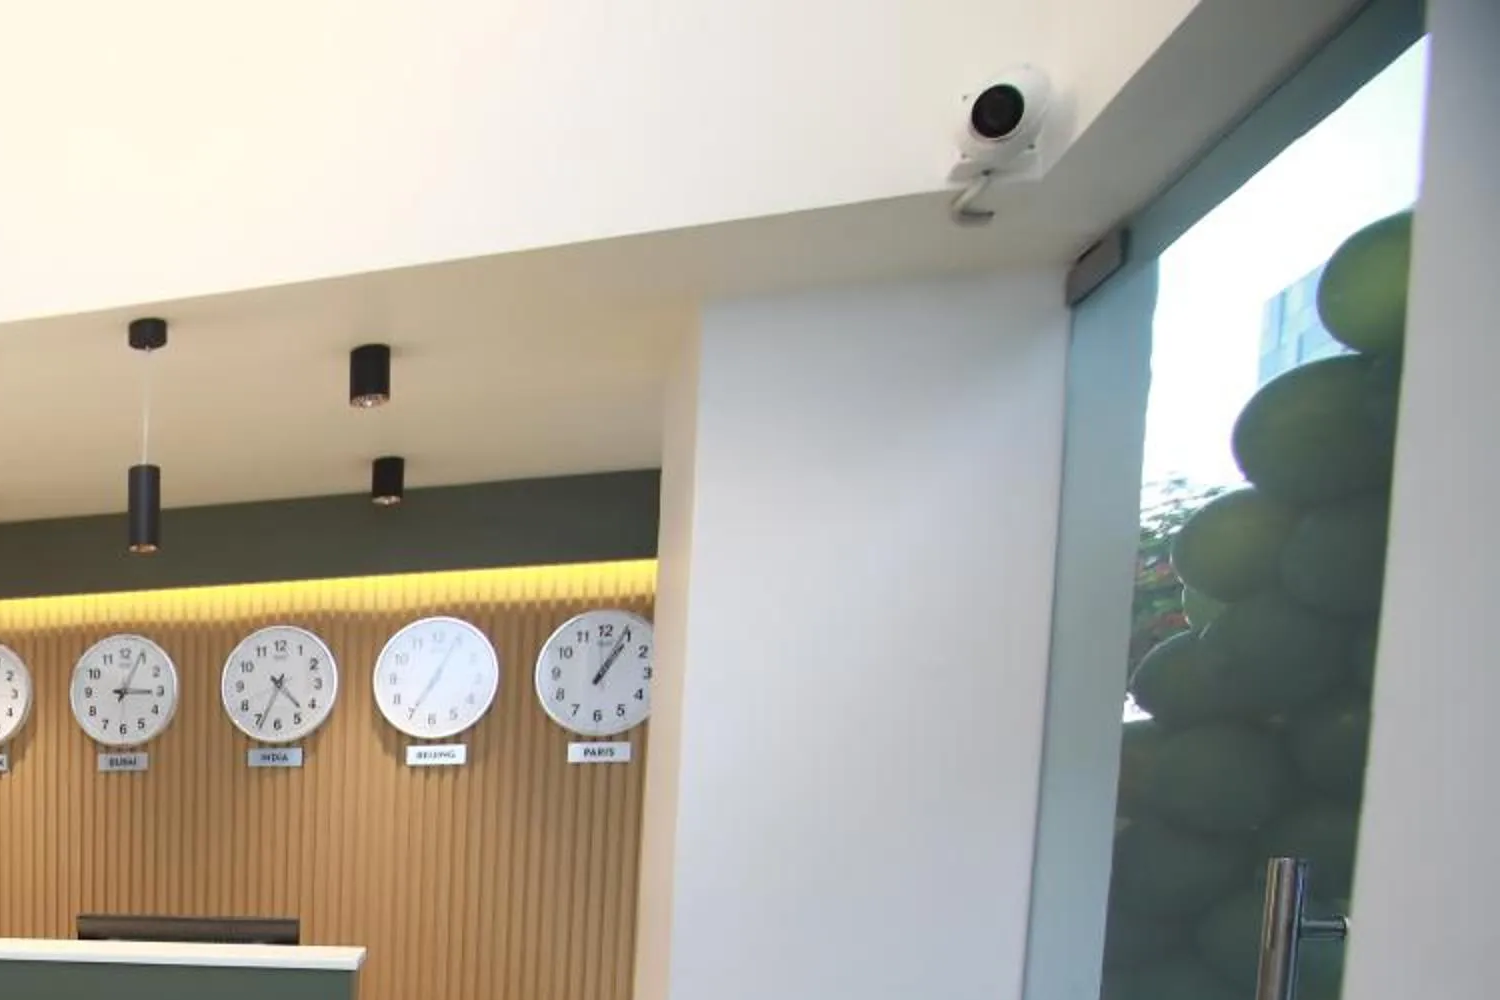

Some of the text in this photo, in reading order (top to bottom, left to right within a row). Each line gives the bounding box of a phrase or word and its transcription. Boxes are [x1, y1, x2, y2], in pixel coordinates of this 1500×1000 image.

[598, 624, 613, 637] 12
[577, 631, 589, 644] 11
[256, 646, 267, 656] 11
[274, 640, 287, 652] 12
[298, 645, 303, 656] 1
[638, 644, 649, 659] 2
[119, 648, 132, 659] 12
[559, 647, 573, 659] 10
[103, 654, 113, 665] 11
[309, 658, 319, 670] 2
[152, 665, 161, 678] 2
[240, 661, 254, 673] 10
[88, 668, 101, 680] 10
[551, 666, 561, 681] 9
[643, 667, 653, 680] 3
[235, 680, 245, 693] 9
[314, 678, 322, 690] 3
[84, 687, 93, 698] 9
[156, 685, 165, 697] 3
[555, 687, 565, 701] 8
[633, 687, 643, 700] 4
[151, 704, 159, 715] 4
[241, 700, 249, 711] 8
[308, 698, 316, 709] 4
[89, 706, 97, 717] 8
[571, 704, 580, 717] 7
[593, 709, 602, 722] 6
[616, 704, 626, 717] 5
[101, 718, 109, 730] 7
[137, 718, 145, 729] 5
[254, 713, 262, 725] 7
[273, 718, 282, 730] 6
[293, 712, 301, 725] 5
[119, 723, 127, 734] 6
[260, 753, 289, 762] INDIA
[583, 748, 615, 757] PARIS
[109, 757, 137, 767] DUBAI
